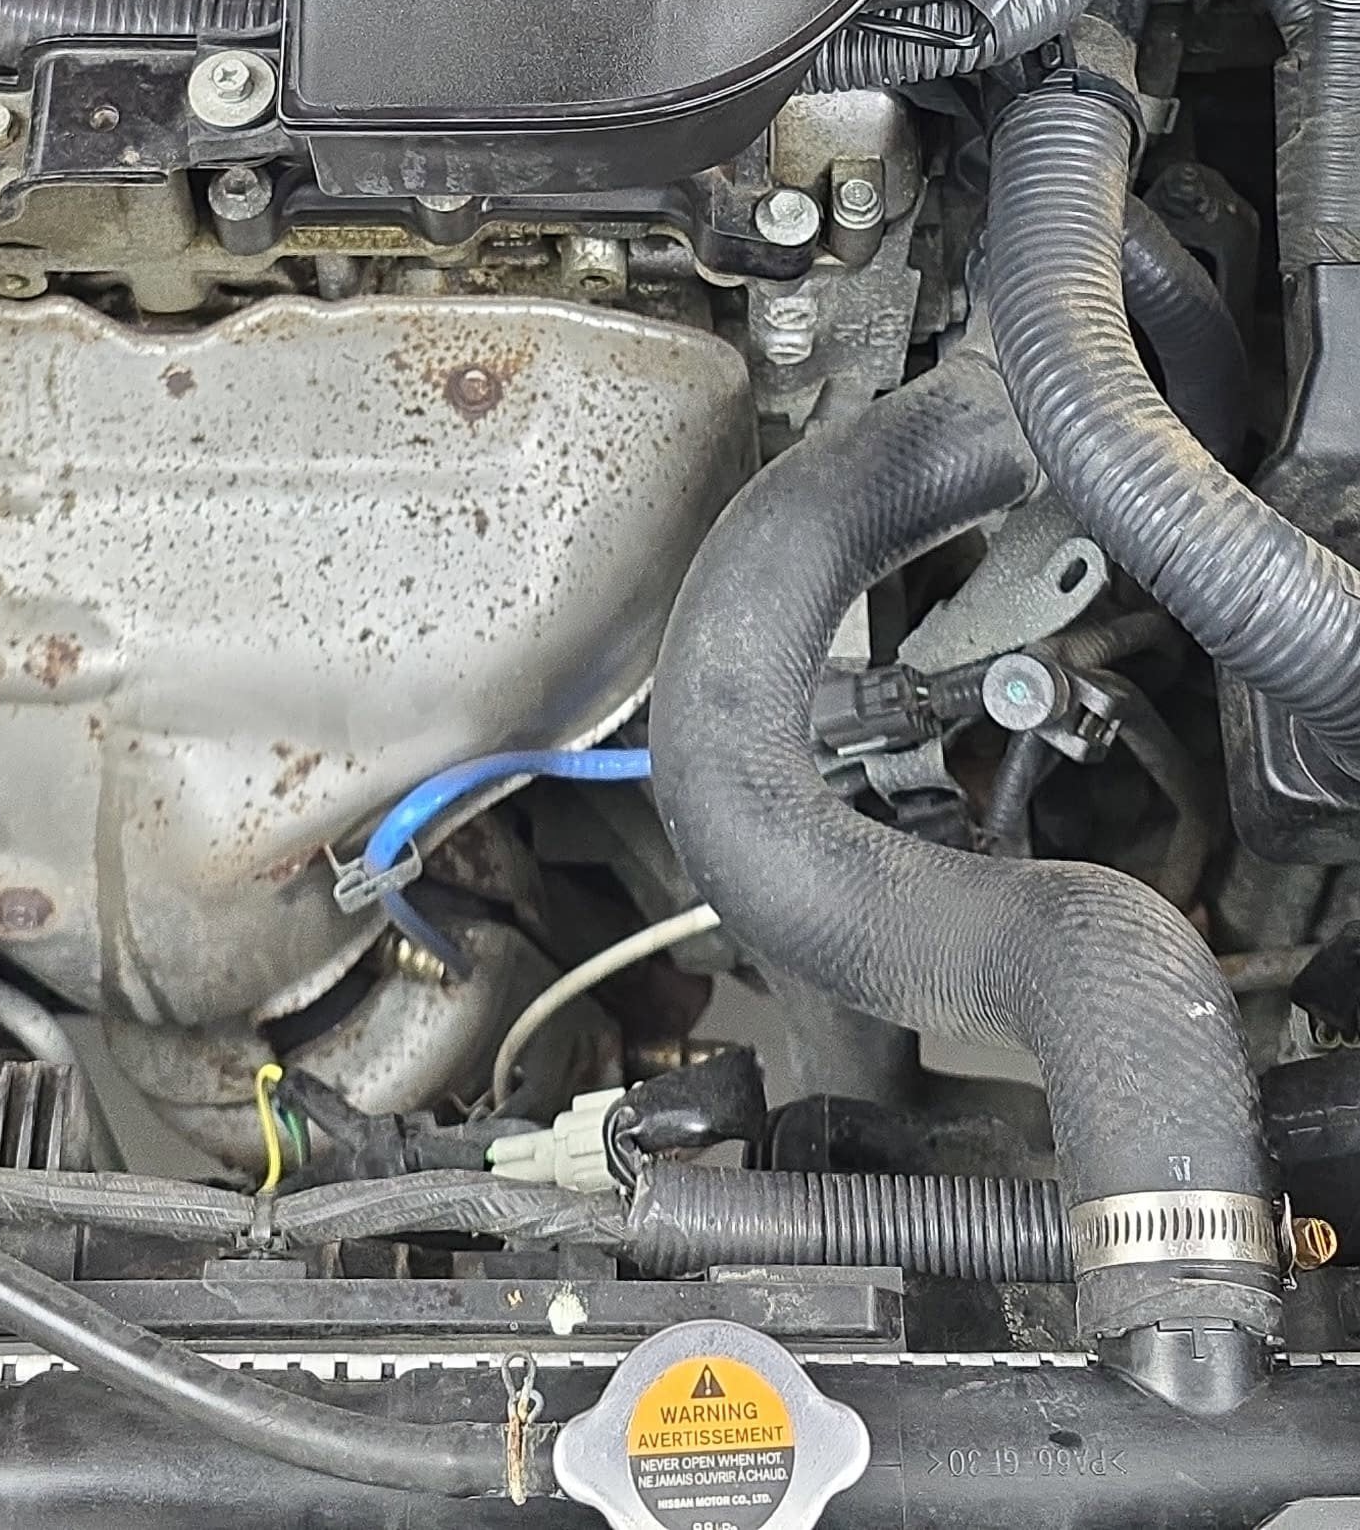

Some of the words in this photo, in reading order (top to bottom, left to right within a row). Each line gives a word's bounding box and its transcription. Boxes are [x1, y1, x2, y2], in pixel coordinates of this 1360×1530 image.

[661, 1402, 758, 1424] WARNING
[638, 1426, 783, 1449] AVERTISSEMENT
[641, 1458, 679, 1472] NEVER
[682, 1456, 715, 1469] OPEN
[718, 1454, 756, 1468] WHEN
[757, 1452, 784, 1465] HOT.
[655, 1473, 693, 1488] JAMAIS
[695, 1471, 736, 1485] OUVRIR
[746, 1468, 788, 1482] CHAUD.
[658, 1498, 694, 1510] NISSAN
[696, 1495, 730, 1508] MOTOR
[752, 1494, 772, 1504] LTD.
